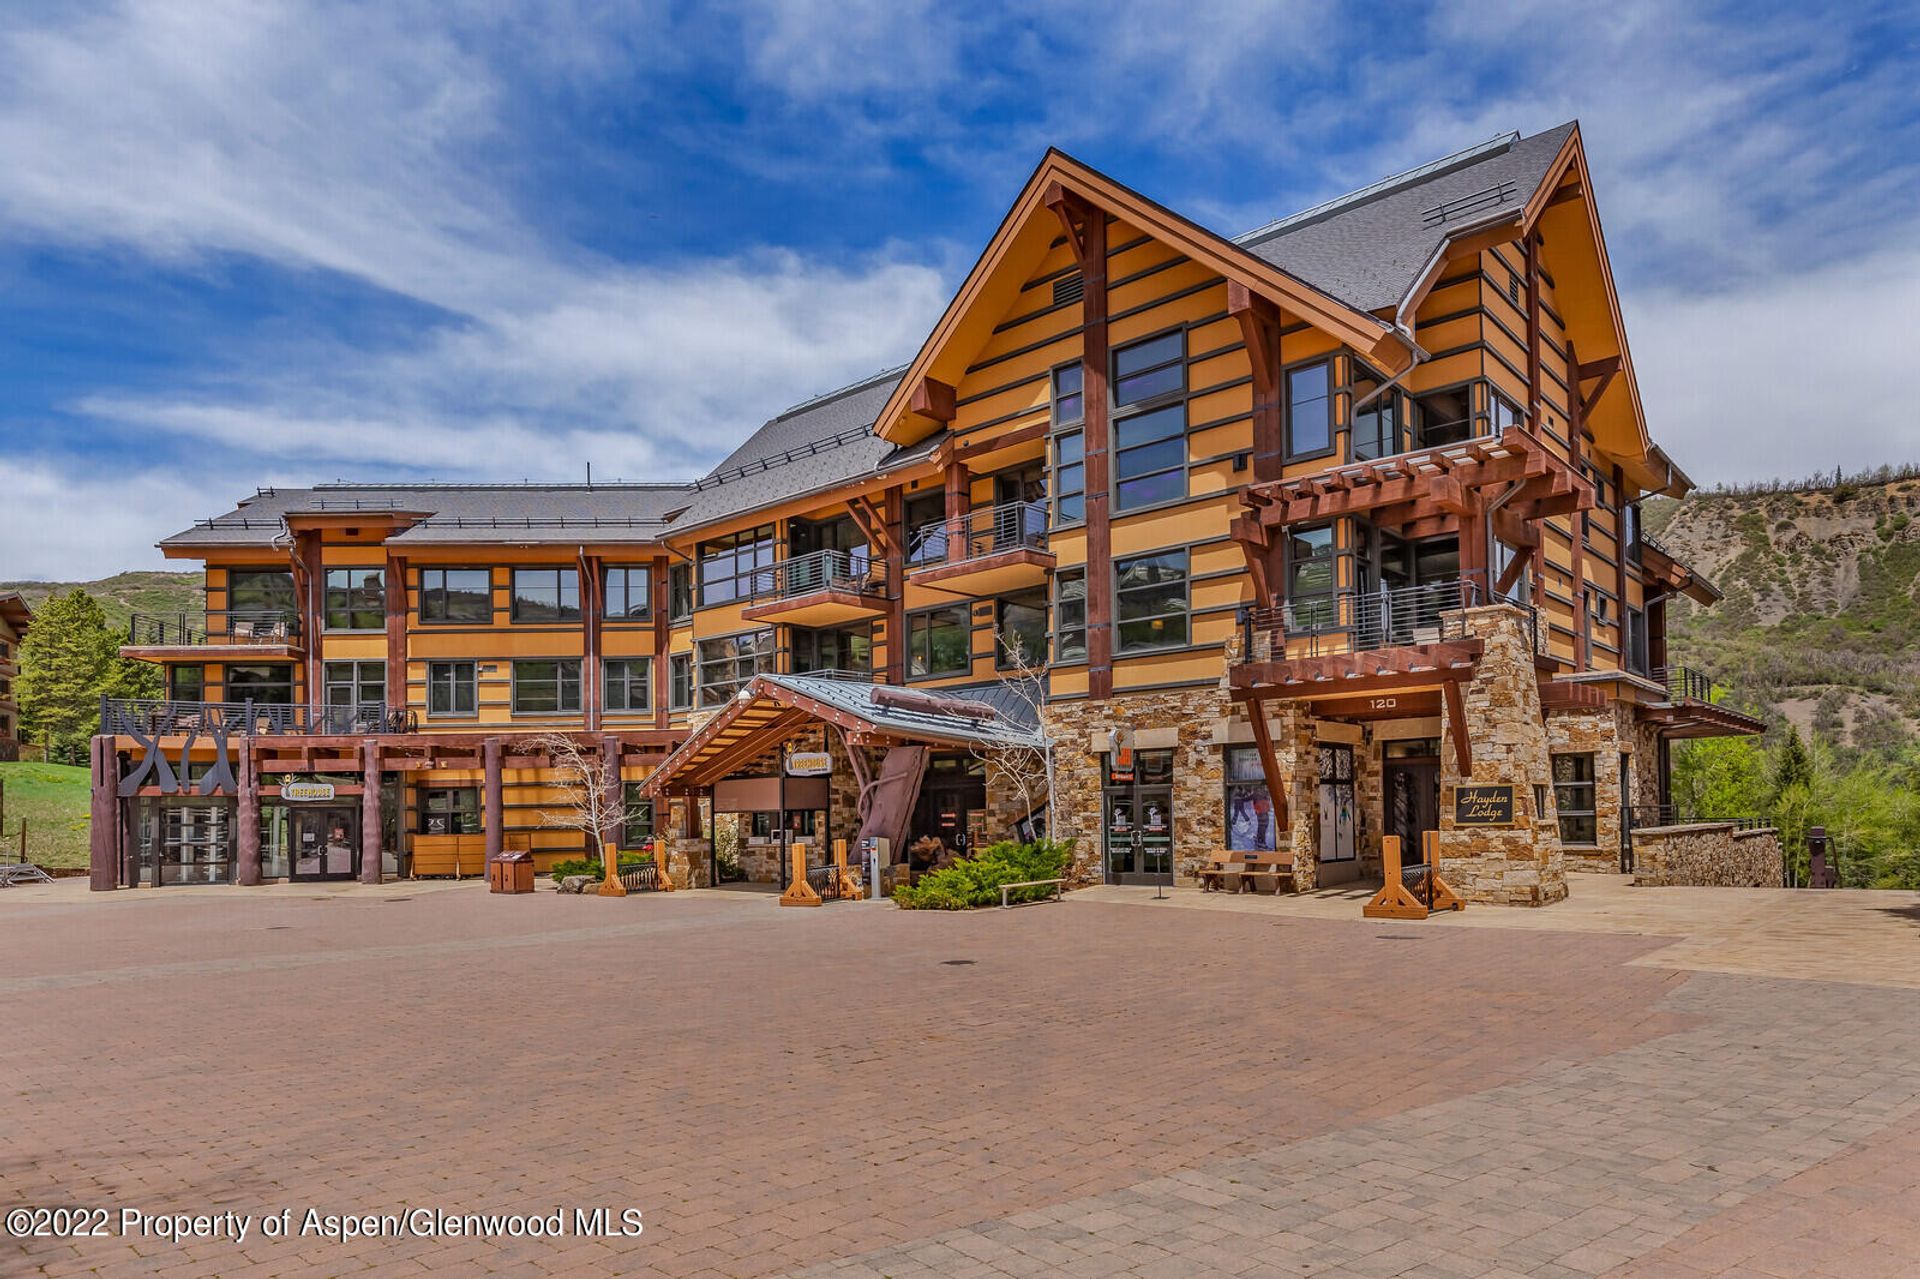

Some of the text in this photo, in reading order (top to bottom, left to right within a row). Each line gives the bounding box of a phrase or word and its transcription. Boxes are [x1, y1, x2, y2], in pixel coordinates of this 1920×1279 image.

[1370, 698, 1397, 709] 120
[1460, 789, 1508, 809] Hayden
[1465, 803, 1504, 822] Lodge
